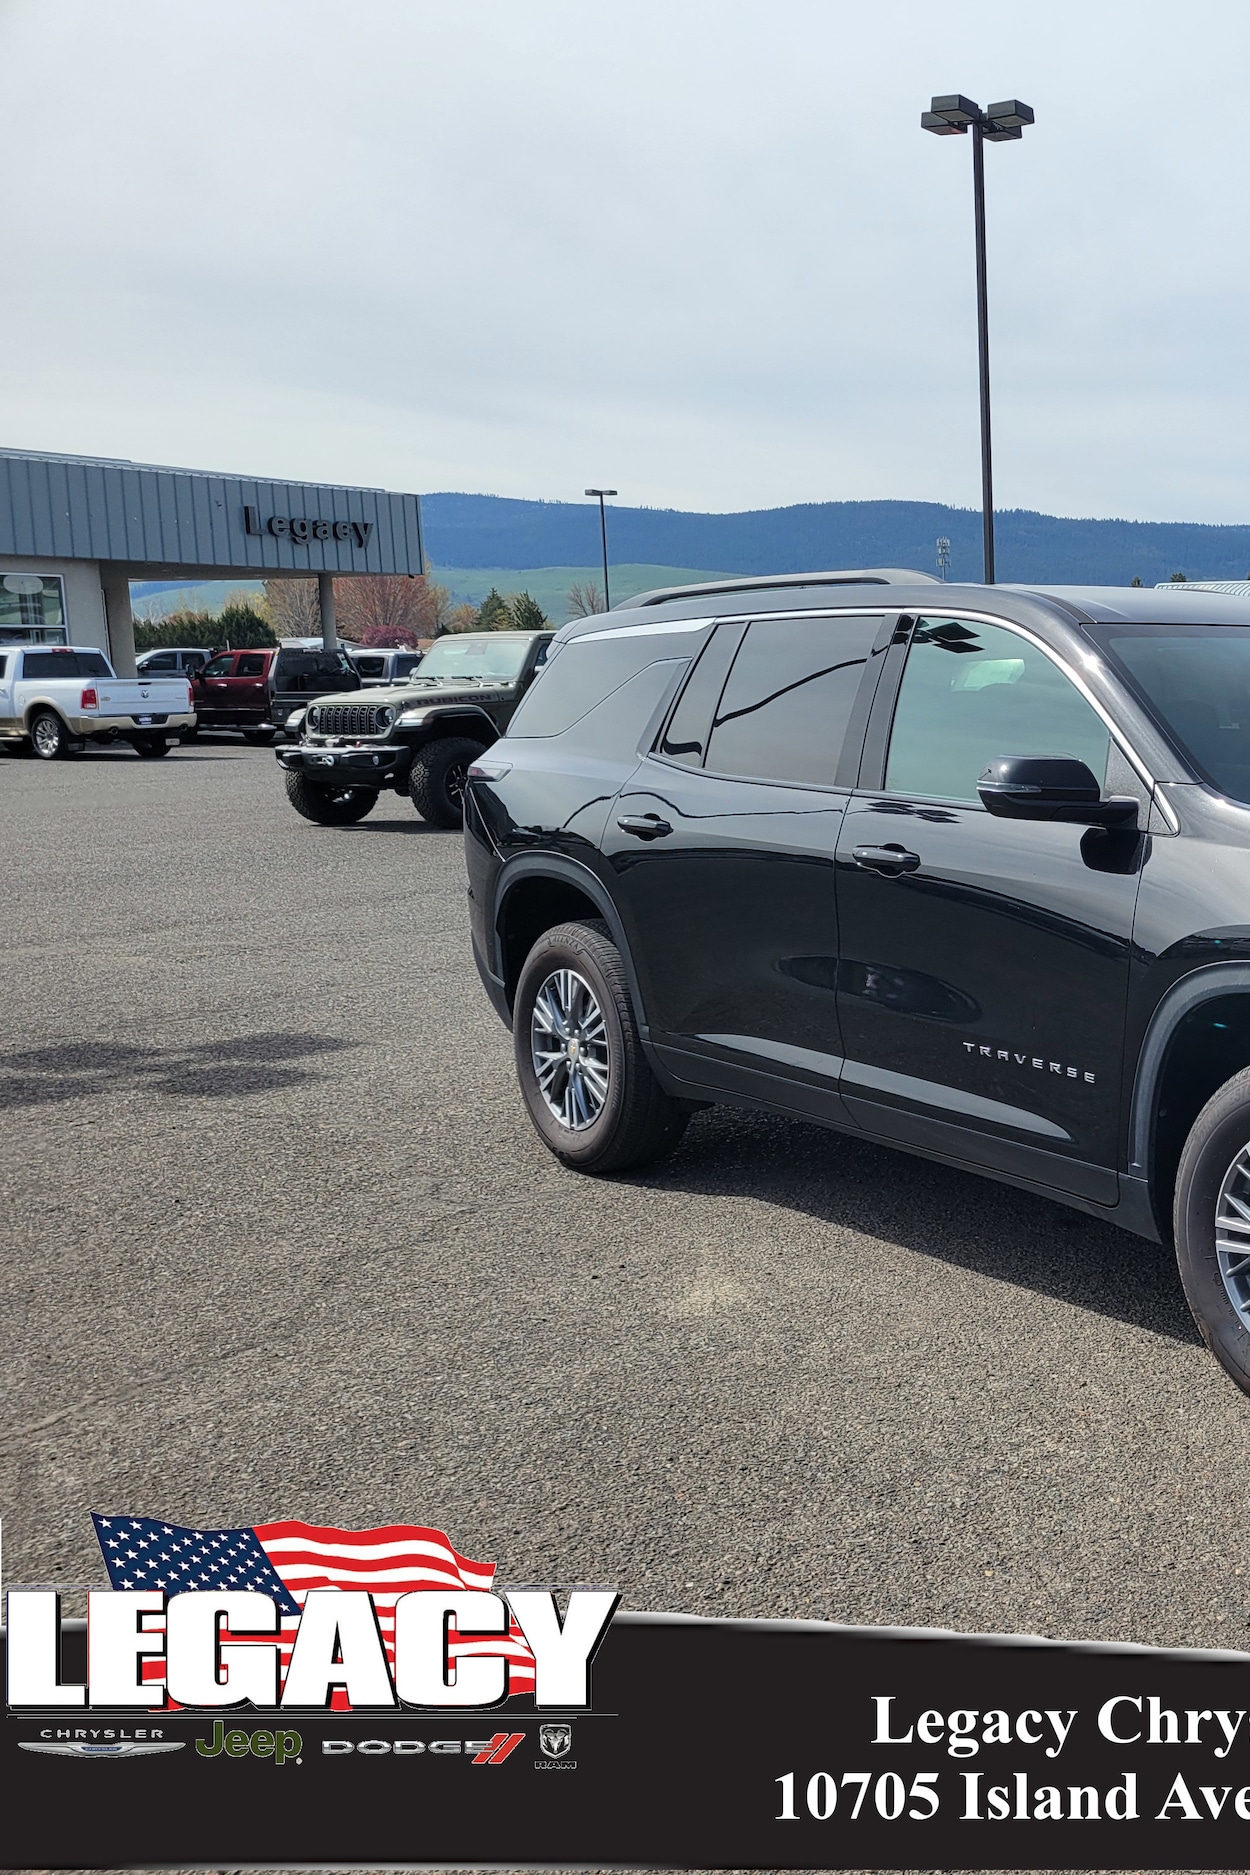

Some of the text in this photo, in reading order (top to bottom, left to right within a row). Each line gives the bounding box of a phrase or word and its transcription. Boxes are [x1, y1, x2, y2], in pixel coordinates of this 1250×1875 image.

[243, 506, 374, 548] Legacy
[417, 695, 492, 706] RUBICON
[962, 1041, 1096, 1084] TRAVERSE
